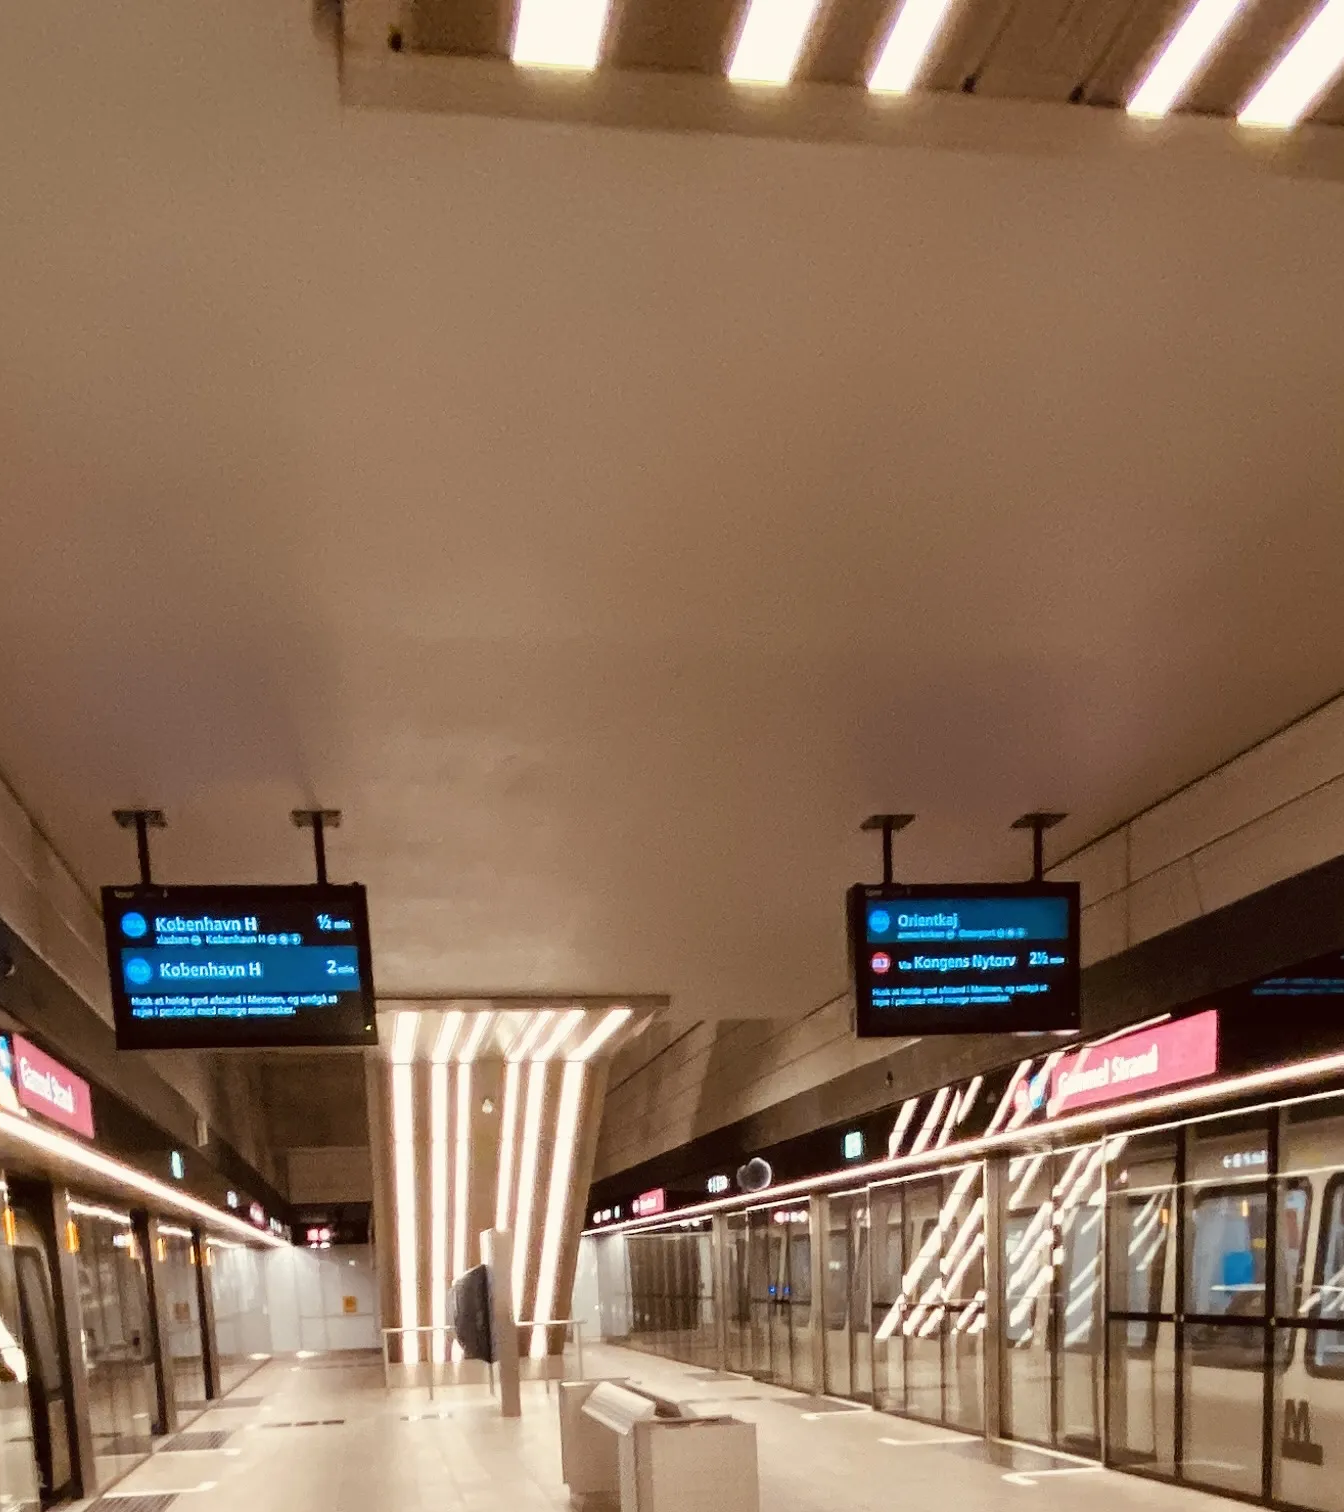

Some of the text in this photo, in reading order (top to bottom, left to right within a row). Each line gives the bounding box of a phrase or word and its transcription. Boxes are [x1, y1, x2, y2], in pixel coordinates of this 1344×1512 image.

[155, 916, 257, 932] København H
[897, 913, 958, 930] Orientkaj
[160, 960, 262, 978] København H
[326, 959, 337, 974] 2
[914, 955, 970, 972] Kongens
[972, 953, 1017, 970] Nytorv
